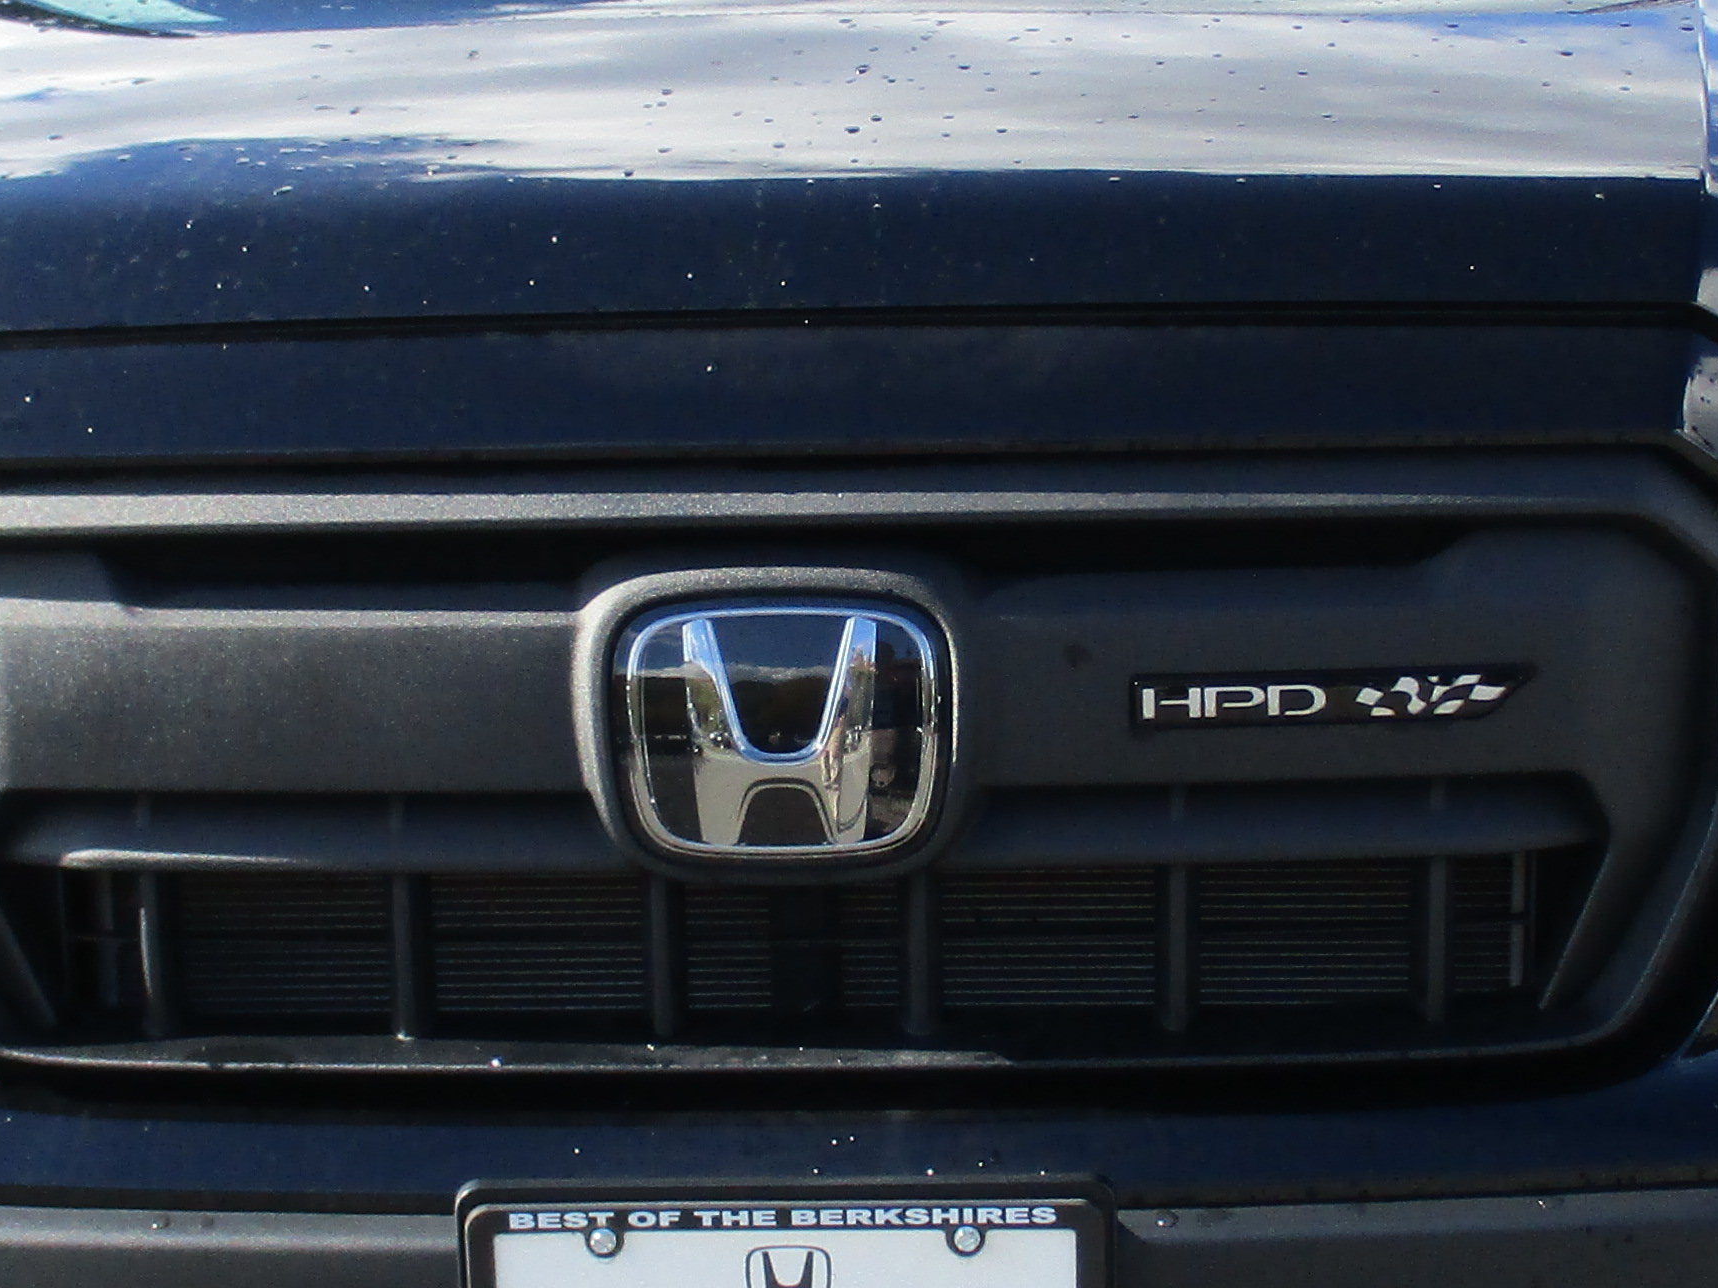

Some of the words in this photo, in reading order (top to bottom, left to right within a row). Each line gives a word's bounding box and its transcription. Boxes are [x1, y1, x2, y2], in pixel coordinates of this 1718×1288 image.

[1141, 683, 1328, 720] HPD
[508, 1211, 615, 1230] BEST
[627, 1210, 682, 1228] OF
[693, 1209, 778, 1228] THE
[790, 1207, 1057, 1226] BERKSHIRES
